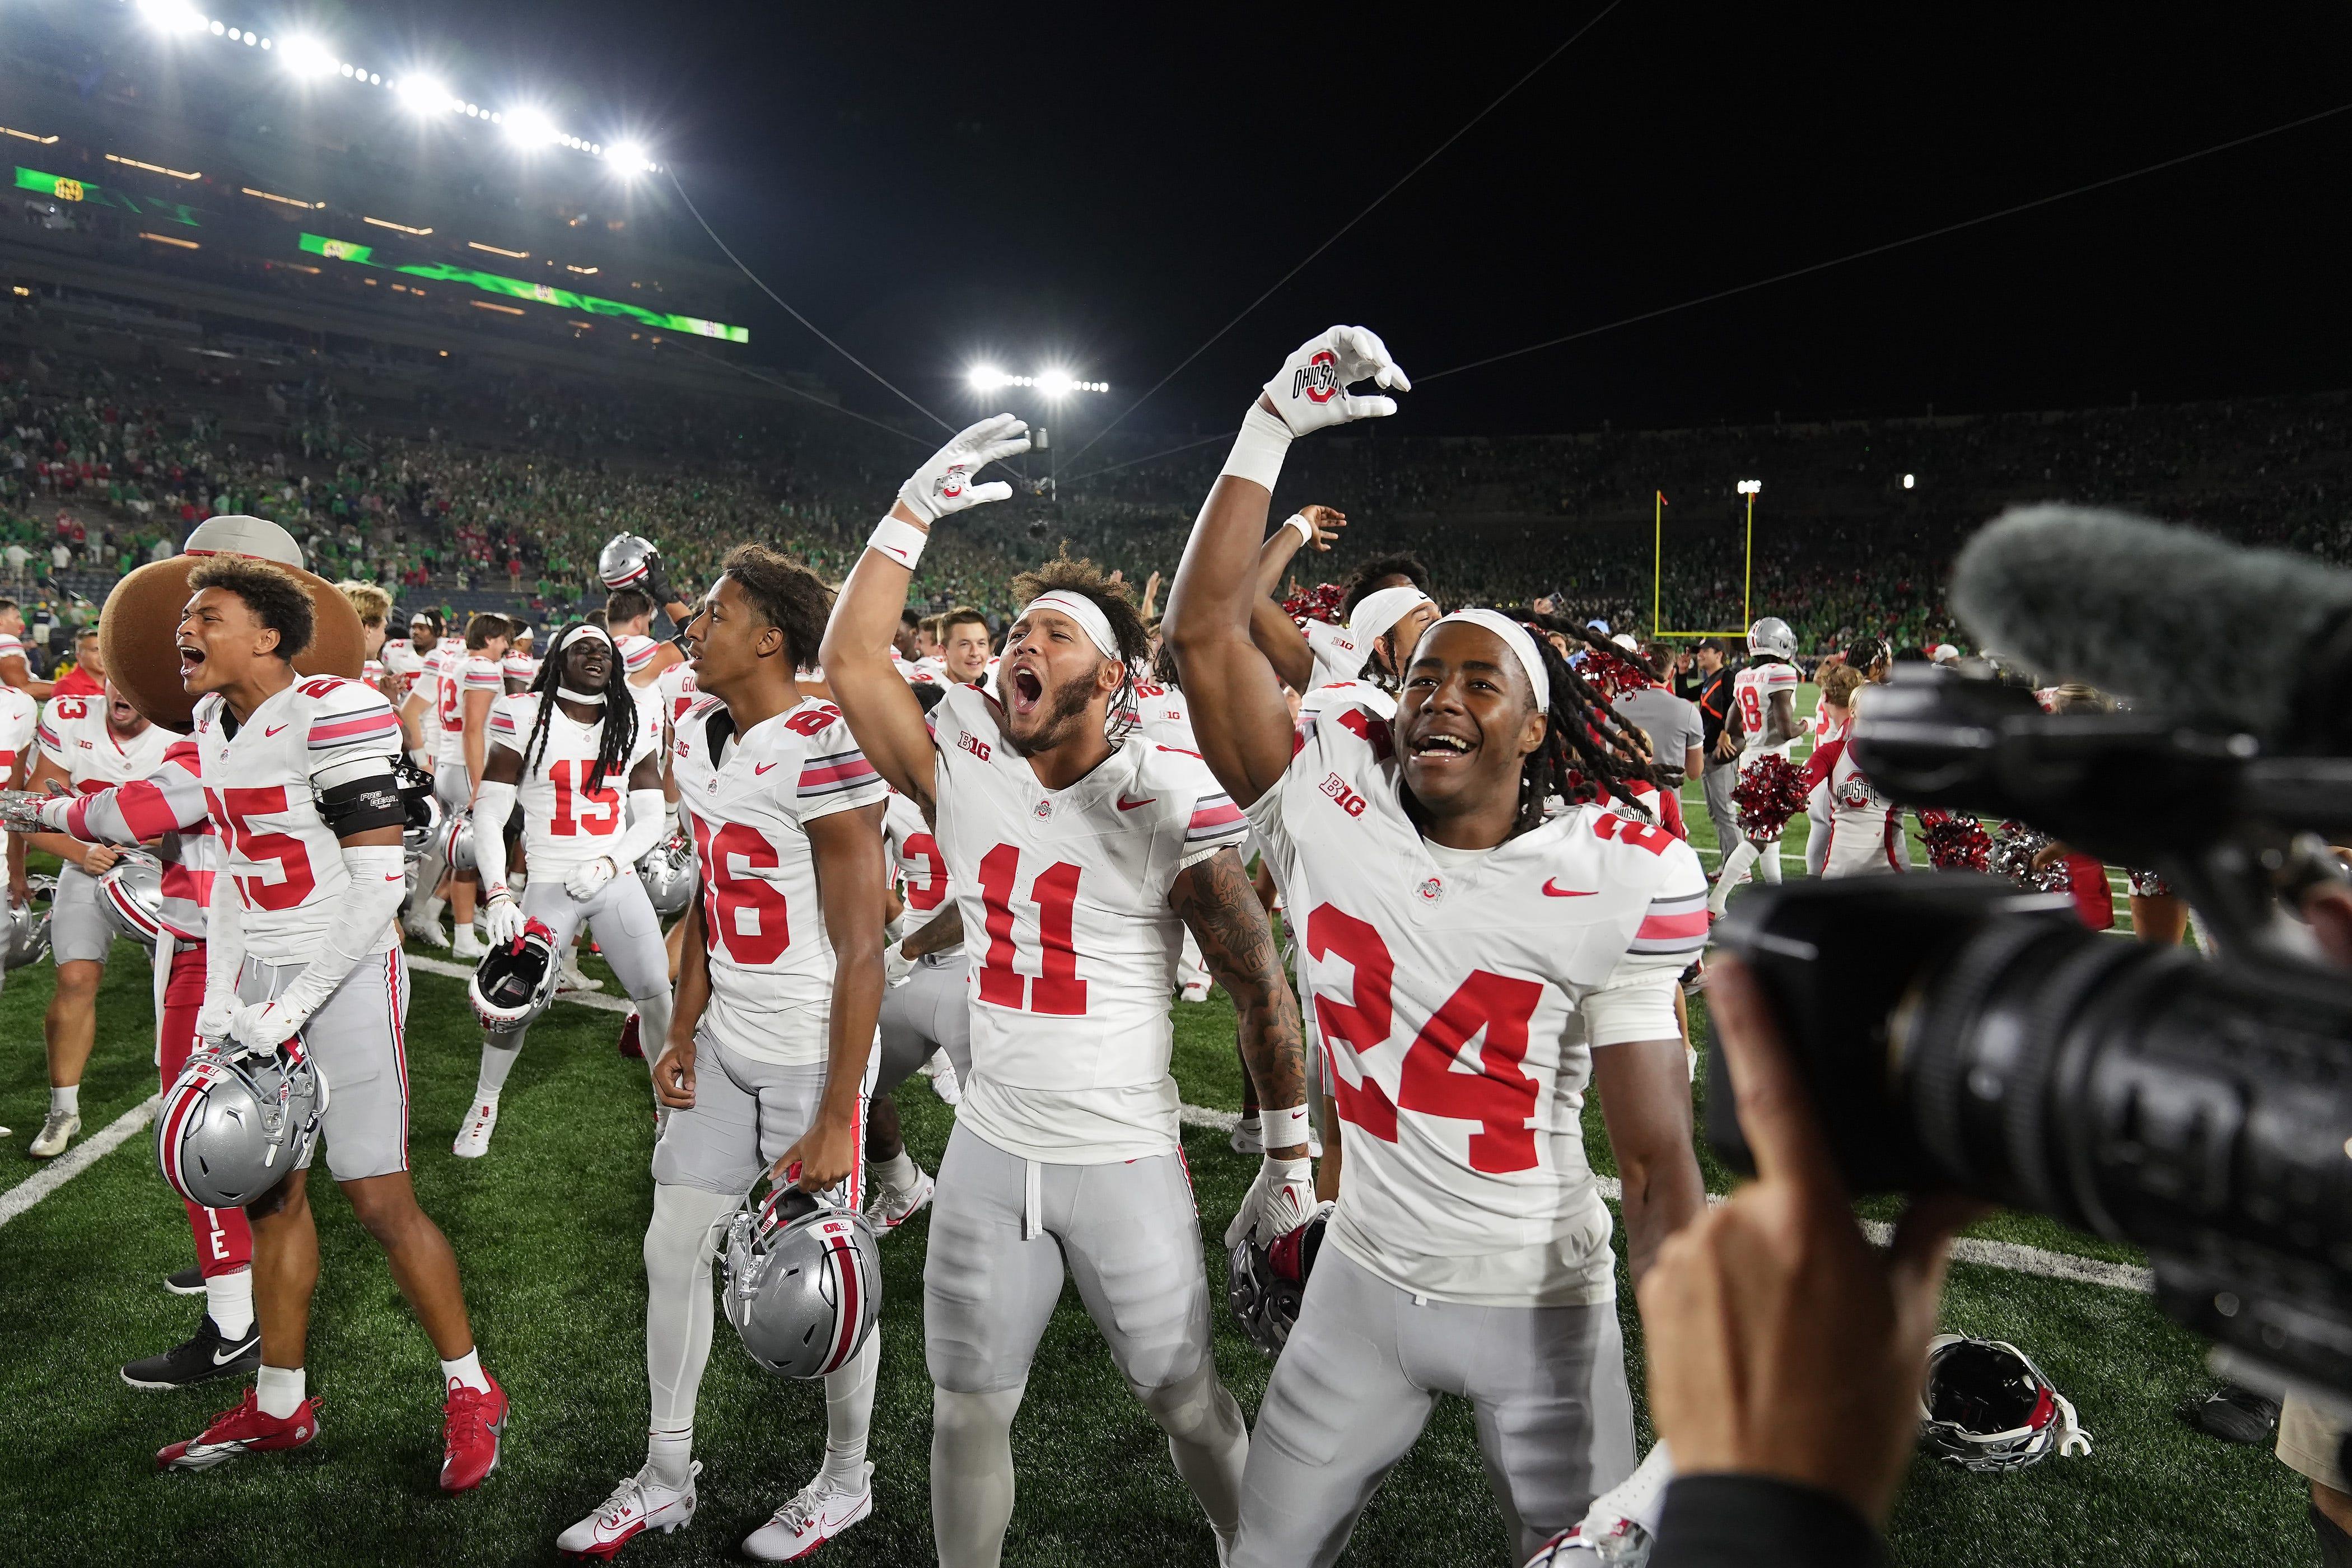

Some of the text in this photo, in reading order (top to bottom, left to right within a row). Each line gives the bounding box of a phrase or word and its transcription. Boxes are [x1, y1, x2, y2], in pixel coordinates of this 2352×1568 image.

[682, 676, 698, 692] GU
[1736, 686, 1762, 732] 18
[360, 790, 382, 801] PRO
[549, 760, 620, 836] 15
[978, 842, 1088, 1015] 11
[1306, 901, 1544, 1174] 24
